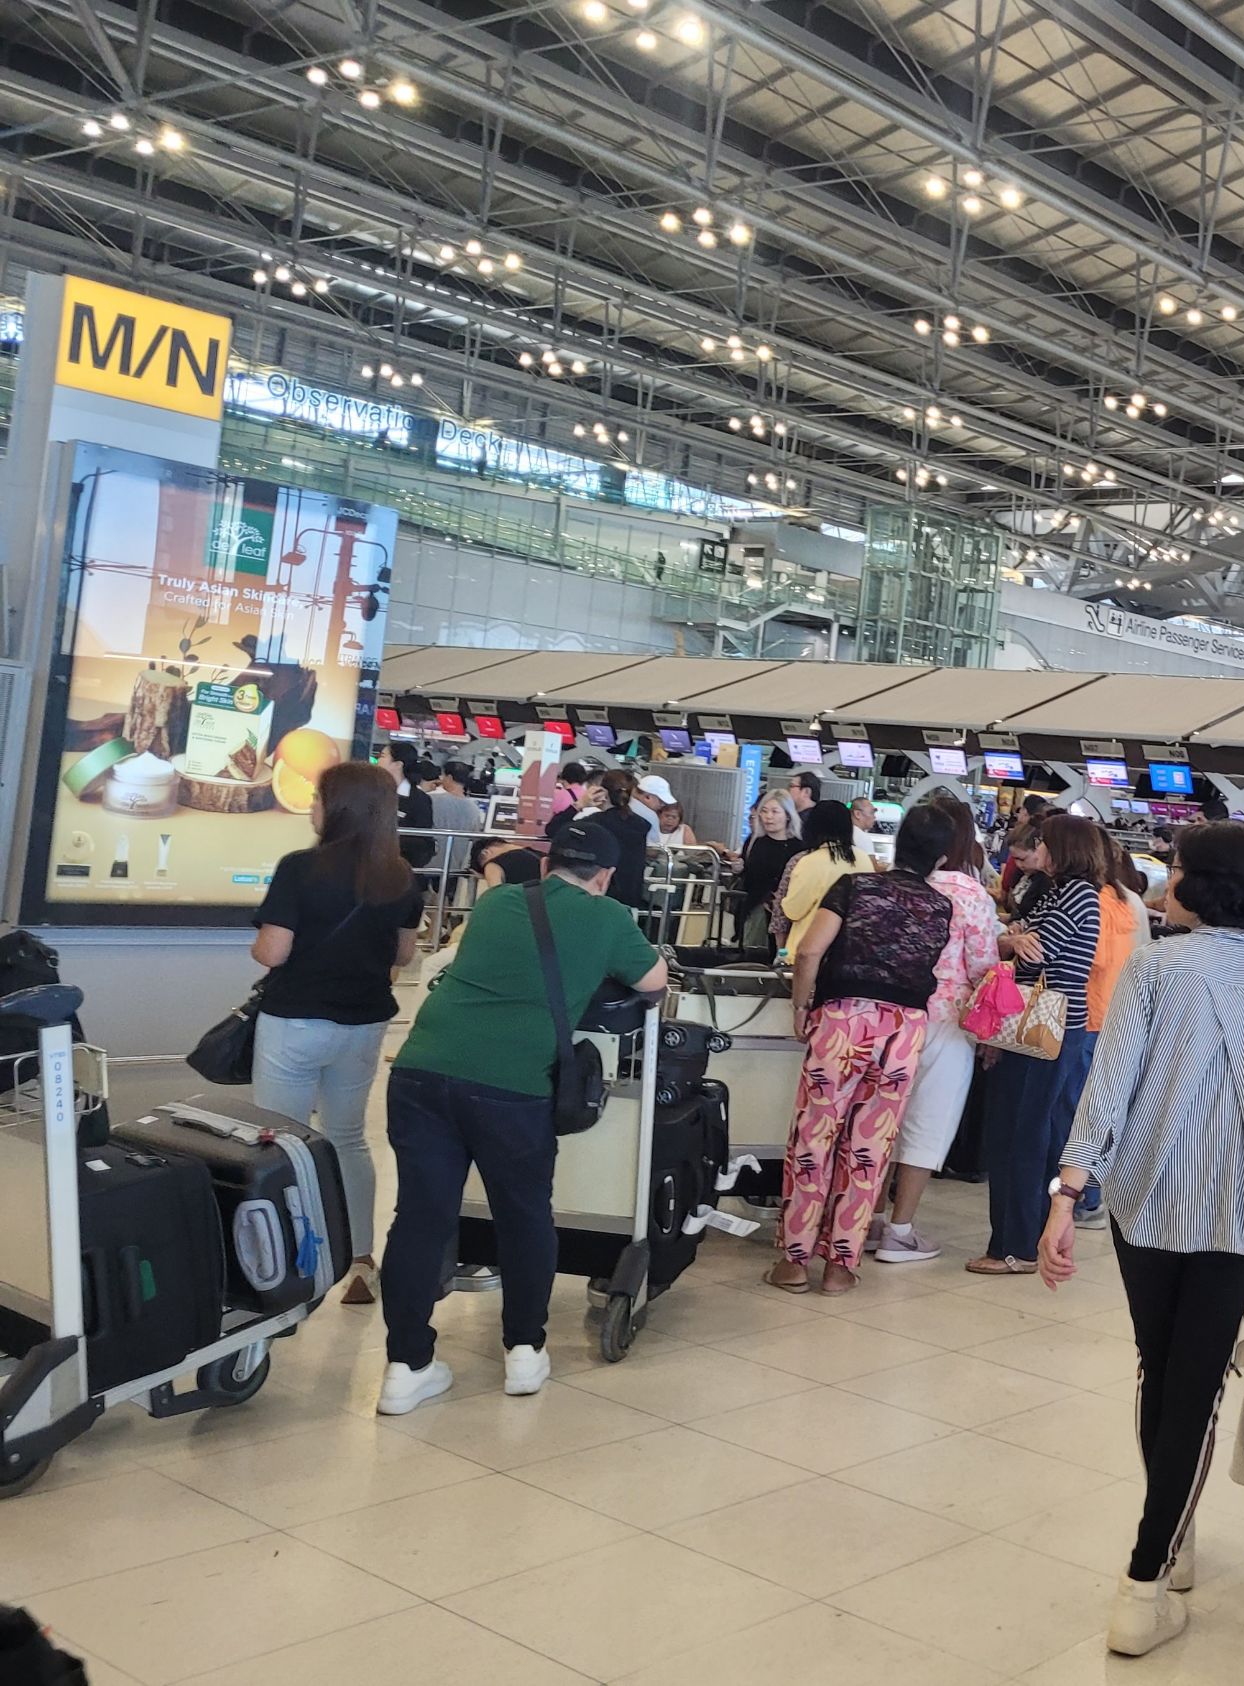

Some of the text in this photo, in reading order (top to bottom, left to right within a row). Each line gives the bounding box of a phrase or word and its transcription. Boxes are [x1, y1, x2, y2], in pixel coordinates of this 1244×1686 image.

[68, 302, 220, 397] M/N
[268, 374, 500, 455] Observatio Deck
[212, 539, 267, 558] de leaf
[158, 574, 195, 592] Truly
[200, 581, 238, 597] Asian
[164, 592, 209, 608] Crafted
[213, 599, 231, 613] for
[235, 602, 265, 617] Asian
[1125, 618, 1157, 640] Airline
[1159, 625, 1209, 653] Passenger
[236, 689, 246, 701] 3
